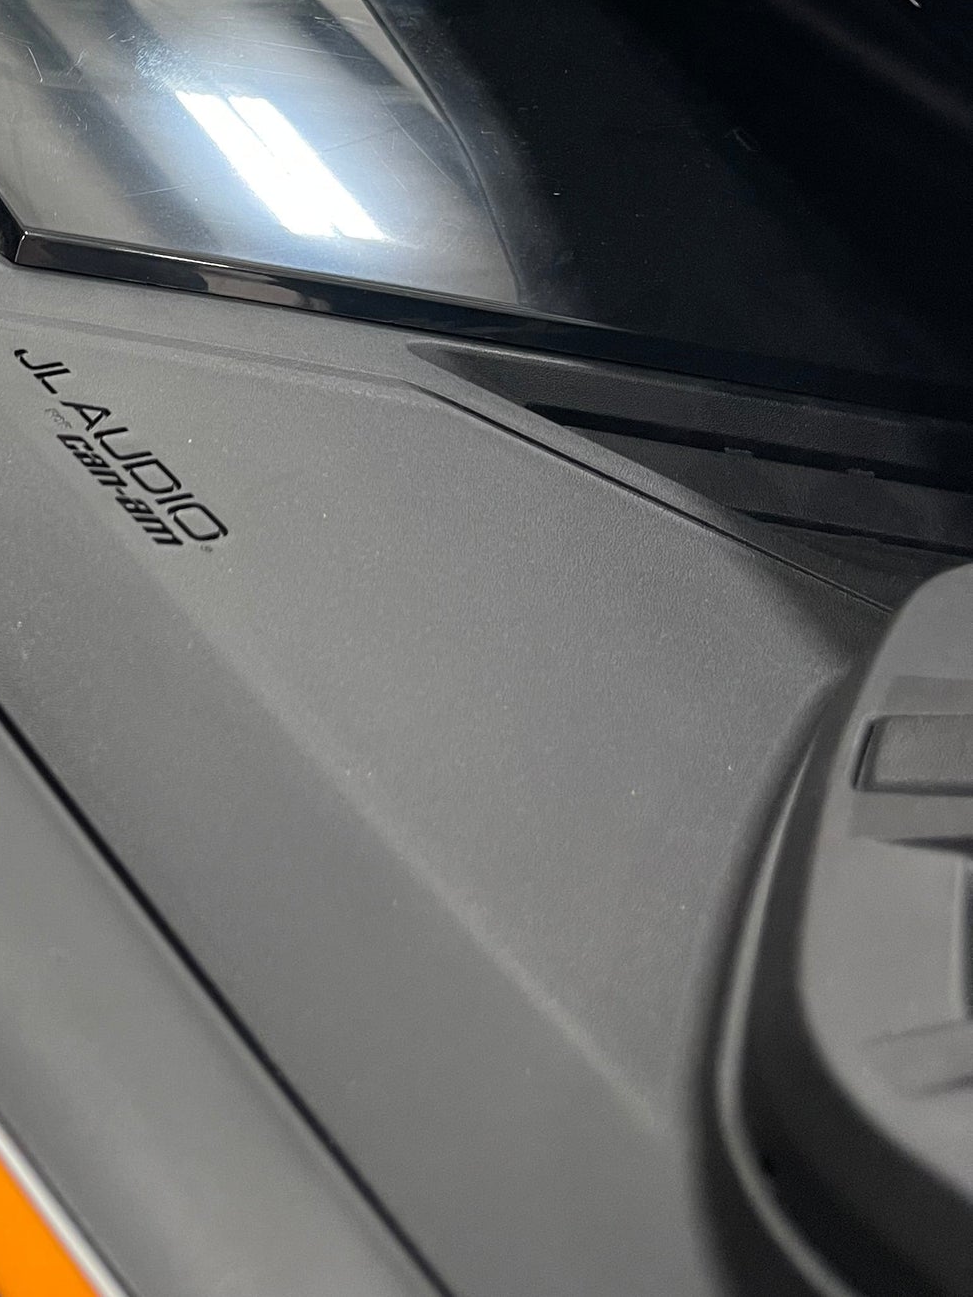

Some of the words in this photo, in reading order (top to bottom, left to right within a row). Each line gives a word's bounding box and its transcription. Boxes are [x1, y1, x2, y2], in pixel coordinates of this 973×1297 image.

[13, 348, 71, 394] JL
[59, 400, 228, 541] AUDIO
[56, 434, 184, 546] can-am
